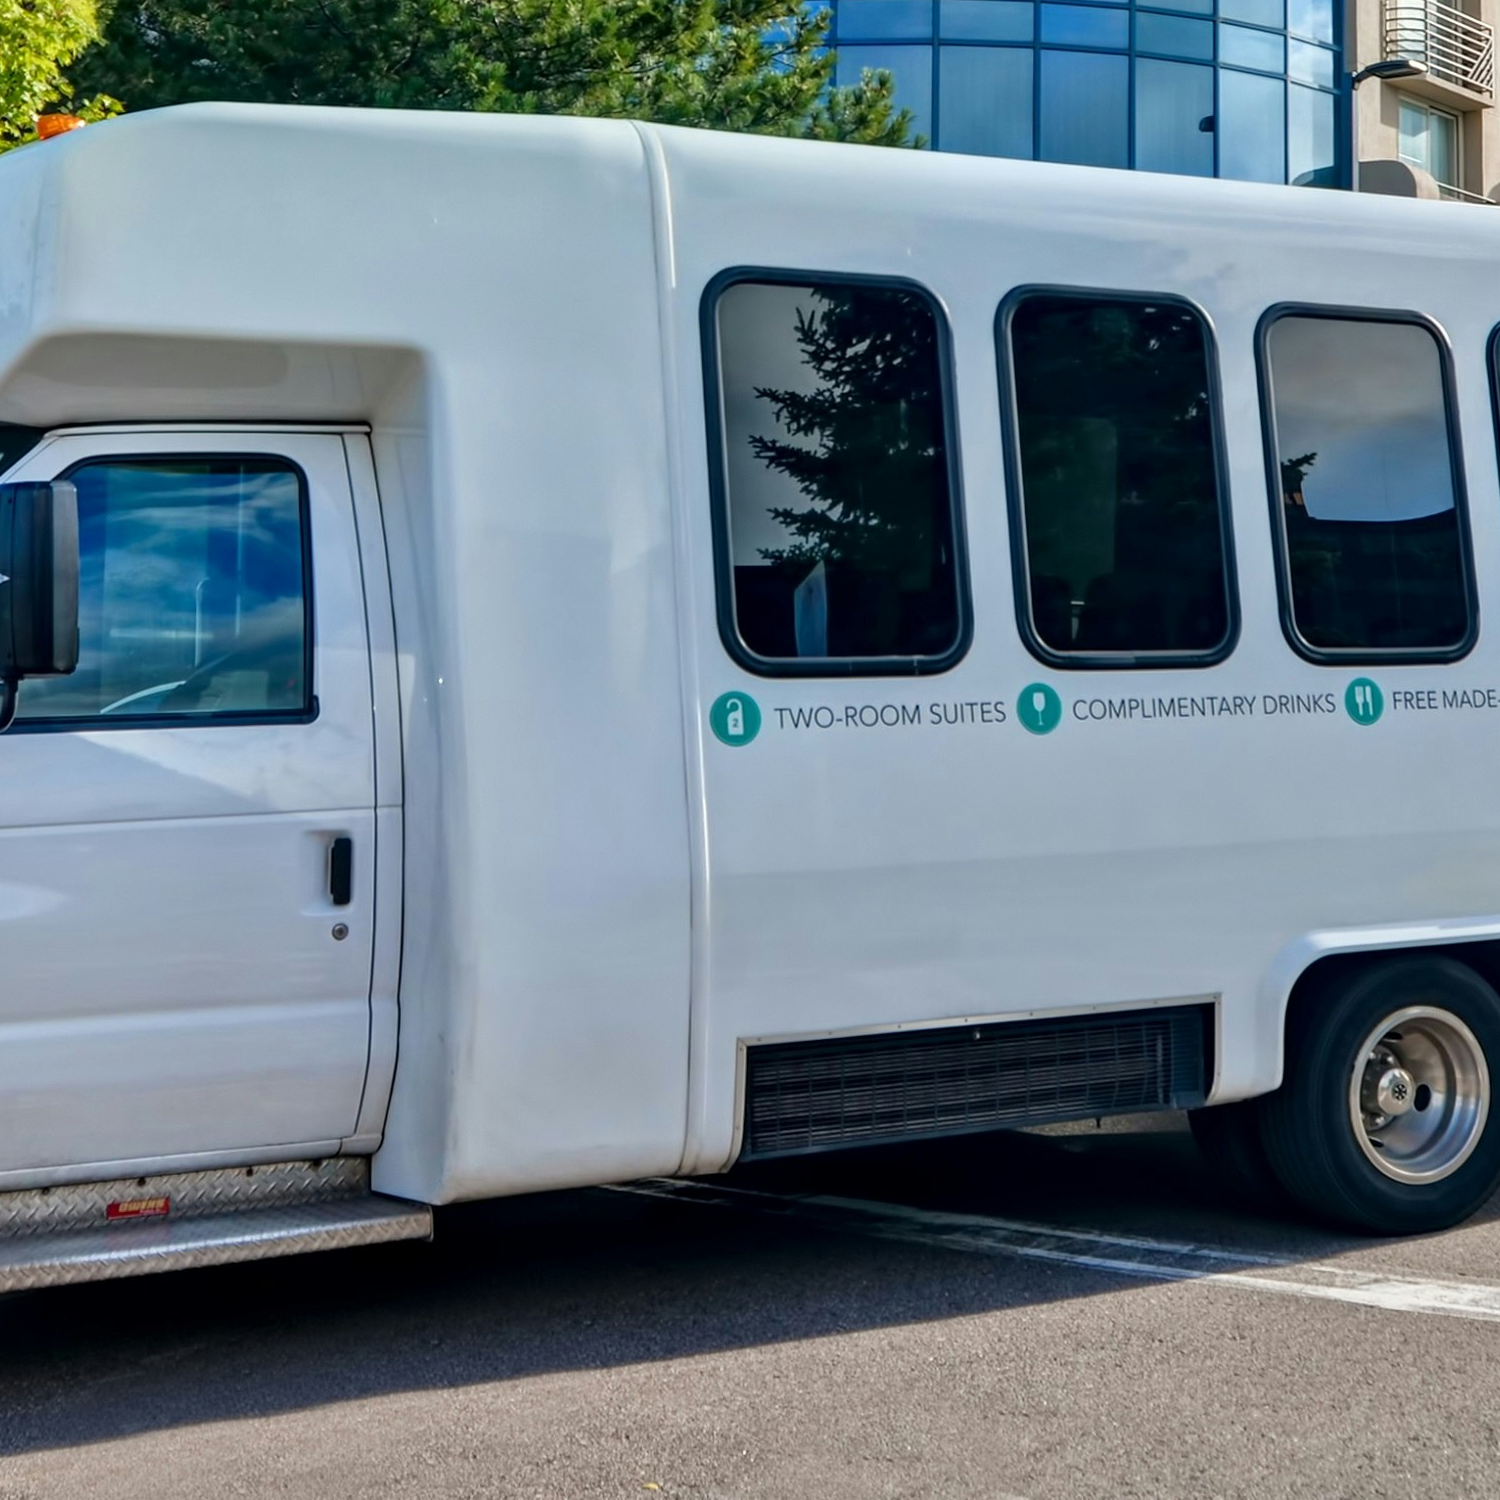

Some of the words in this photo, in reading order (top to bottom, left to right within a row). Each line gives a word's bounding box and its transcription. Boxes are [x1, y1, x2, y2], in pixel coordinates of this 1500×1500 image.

[773, 704, 922, 730] TWO-ROOM
[929, 700, 1007, 725] SUITES
[1072, 694, 1257, 722] COMPLIMENTARY
[1262, 692, 1336, 716] DRINKS
[1392, 689, 1439, 711] FREE
